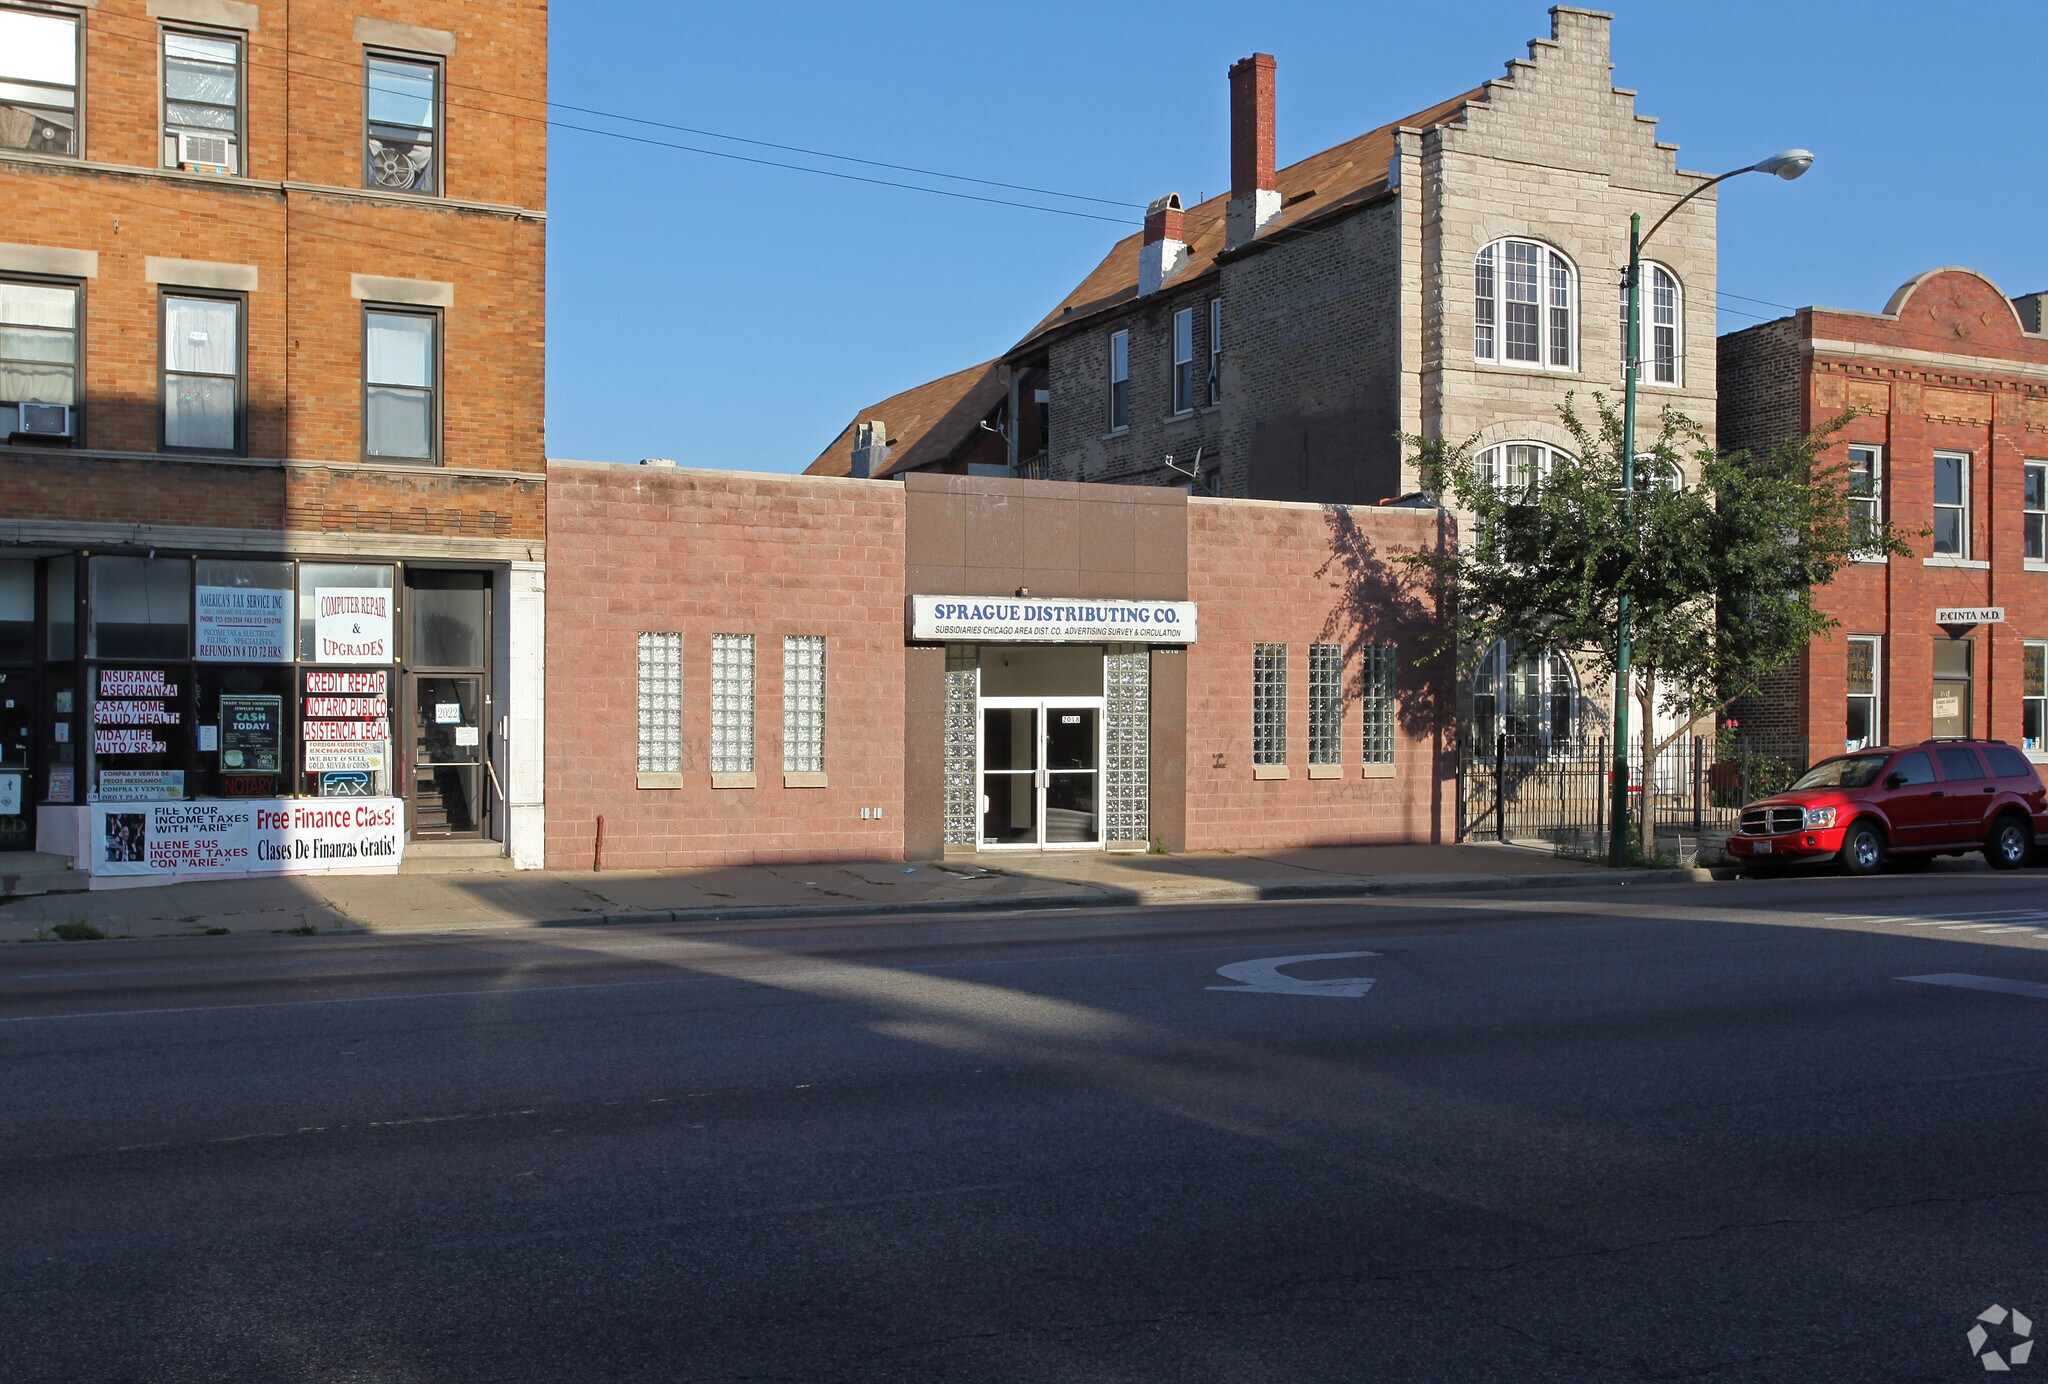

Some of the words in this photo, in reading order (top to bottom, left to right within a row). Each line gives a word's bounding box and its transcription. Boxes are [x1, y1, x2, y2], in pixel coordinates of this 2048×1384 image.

[200, 593, 231, 608] AMERICA'S
[233, 594, 244, 608] TAX
[247, 595, 270, 609] SERVICE
[273, 595, 283, 609] INC
[321, 596, 360, 618] COMPUTER
[361, 596, 387, 618] REPAIR
[934, 604, 1022, 621] SPRAGUE
[1024, 605, 1150, 623] DISTRIBUTING
[1153, 608, 1180, 624] CO.
[204, 629, 226, 638] INCOME
[228, 630, 238, 638] TAX
[244, 630, 276, 639] ELECTRONIC
[352, 622, 362, 634] &
[935, 625, 982, 635] SUBSIDIARIES
[983, 626, 1013, 635] CHICAGO
[1014, 626, 1033, 635] AREA
[1034, 626, 1050, 635] DIST.
[1051, 627, 1062, 635] CO.
[1065, 627, 1106, 636] ADVERTISING
[1107, 627, 1133, 636] SURVEY
[1134, 628, 1139, 636] &
[1140, 628, 1181, 637] CIRCULATION
[207, 637, 229, 645] FILING
[234, 638, 272, 646] SPECIALISTS
[323, 638, 384, 656] UPGRADES
[200, 645, 232, 658] REFUNDS
[233, 646, 241, 658] IN
[243, 646, 247, 658] 8
[248, 646, 258, 658] TO
[260, 647, 267, 658] 72
[268, 646, 282, 658] HRS
[101, 671, 164, 683] INSURANCE
[307, 672, 345, 692] CREDIT
[348, 673, 385, 692] REPAIR
[102, 684, 177, 696] ASEGURANZA
[94, 701, 165, 713] CASA/HOME
[306, 698, 348, 717] NOTARIO
[351, 698, 387, 717] PUBLICO
[437, 707, 458, 719] 2022
[94, 713, 180, 724] SALUD/HEALTH
[236, 712, 266, 722] CA$H
[233, 723, 270, 731] TODAY!
[304, 722, 357, 741] ASISTENCIA
[361, 722, 389, 741] LEGAL
[95, 730, 152, 742] VIDA/LIFE
[96, 741, 165, 754] AUTO/SR-22
[308, 762, 326, 770] GOLD,
[327, 762, 346, 770] SILVER
[353, 762, 370, 770] COINS
[225, 777, 276, 795] NOTARY
[324, 781, 369, 796] FAX
[155, 807, 179, 815] FILE
[184, 806, 218, 815] YOUR
[155, 815, 202, 825] INCOME
[208, 814, 249, 823] TAXES
[257, 808, 290, 830] Free
[295, 807, 351, 830] Finance
[356, 805, 395, 827] Class!
[155, 825, 189, 834] WITH
[193, 823, 233, 832] "ARIE"
[150, 841, 189, 850] LLENE
[194, 840, 219, 849] SUS
[257, 839, 292, 860] Clases
[295, 838, 310, 860] De
[313, 837, 358, 859] Finanzas
[360, 835, 395, 857] Gratis!
[150, 849, 201, 859] INCOME
[206, 848, 248, 858] TAXES
[150, 859, 178, 868] CON
